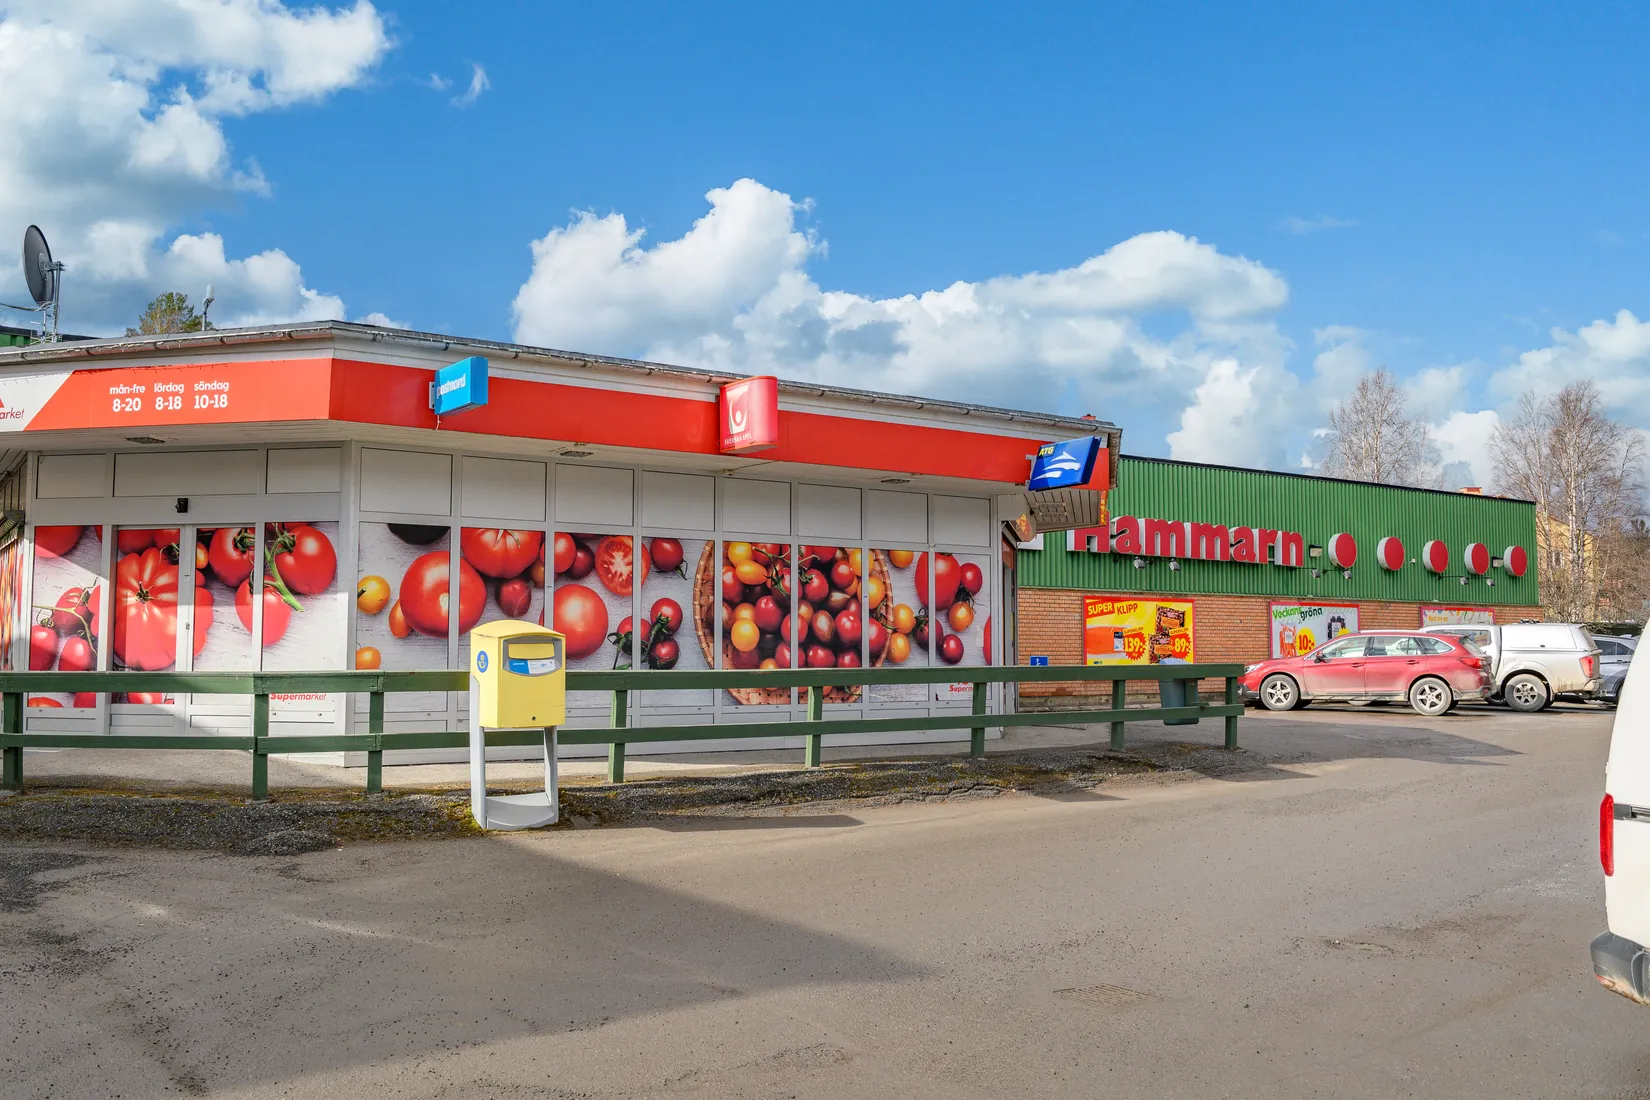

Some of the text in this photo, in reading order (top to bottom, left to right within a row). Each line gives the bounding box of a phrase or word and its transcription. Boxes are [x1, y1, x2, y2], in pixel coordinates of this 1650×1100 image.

[109, 380, 230, 395] mån-fre lördag söndag
[112, 394, 228, 412] 8-20 8-18 10-18
[1038, 446, 1054, 456] ATG
[1087, 602, 1138, 615] SUPER KLIPP
[1272, 606, 1323, 621] Veckans gröna
[949, 684, 973, 693] Superm
[270, 692, 327, 702] Supermarket
